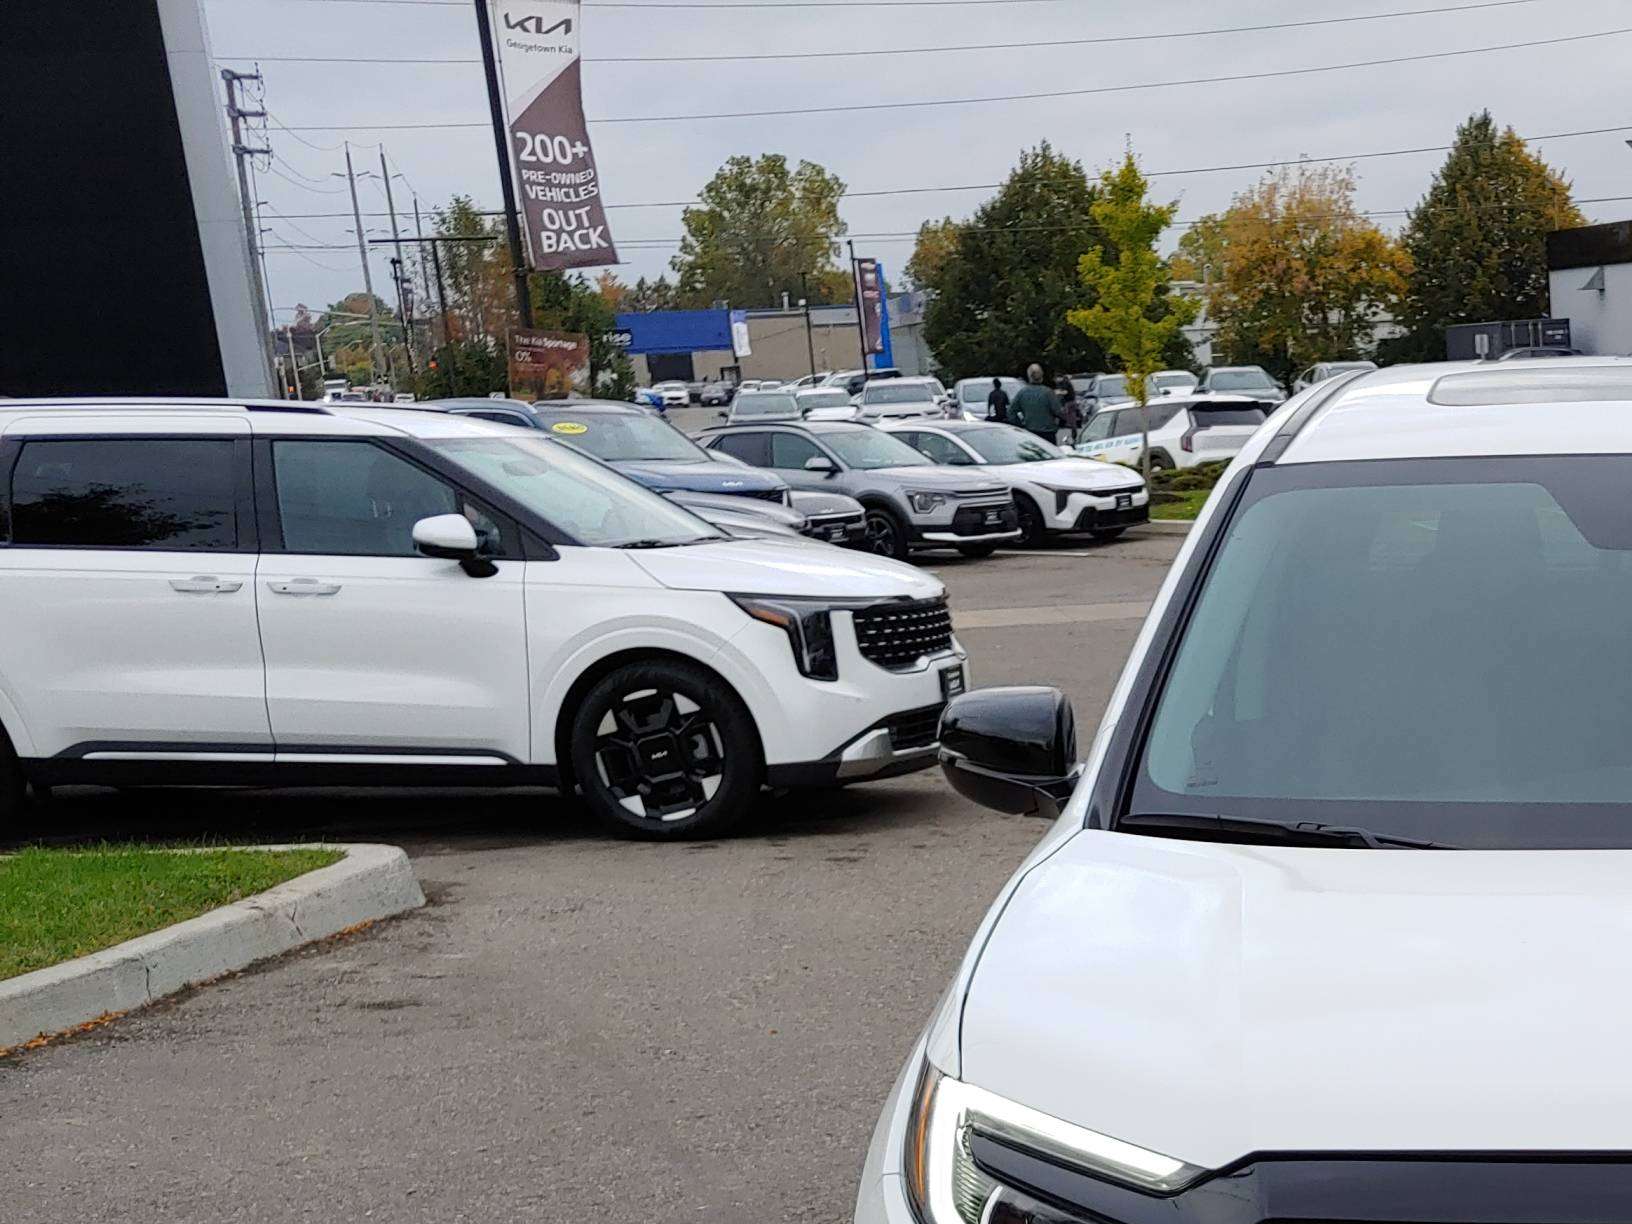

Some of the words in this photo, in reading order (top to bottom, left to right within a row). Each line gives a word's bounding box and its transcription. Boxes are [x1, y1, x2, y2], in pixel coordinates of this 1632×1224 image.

[506, 38, 556, 53] Georgetown
[559, 45, 573, 54] Kia
[515, 131, 588, 165] 200+
[521, 168, 594, 185] PRE-OWNED
[525, 182, 599, 203] VEHICLES
[542, 205, 591, 231] OUT
[541, 225, 609, 254] BACK
